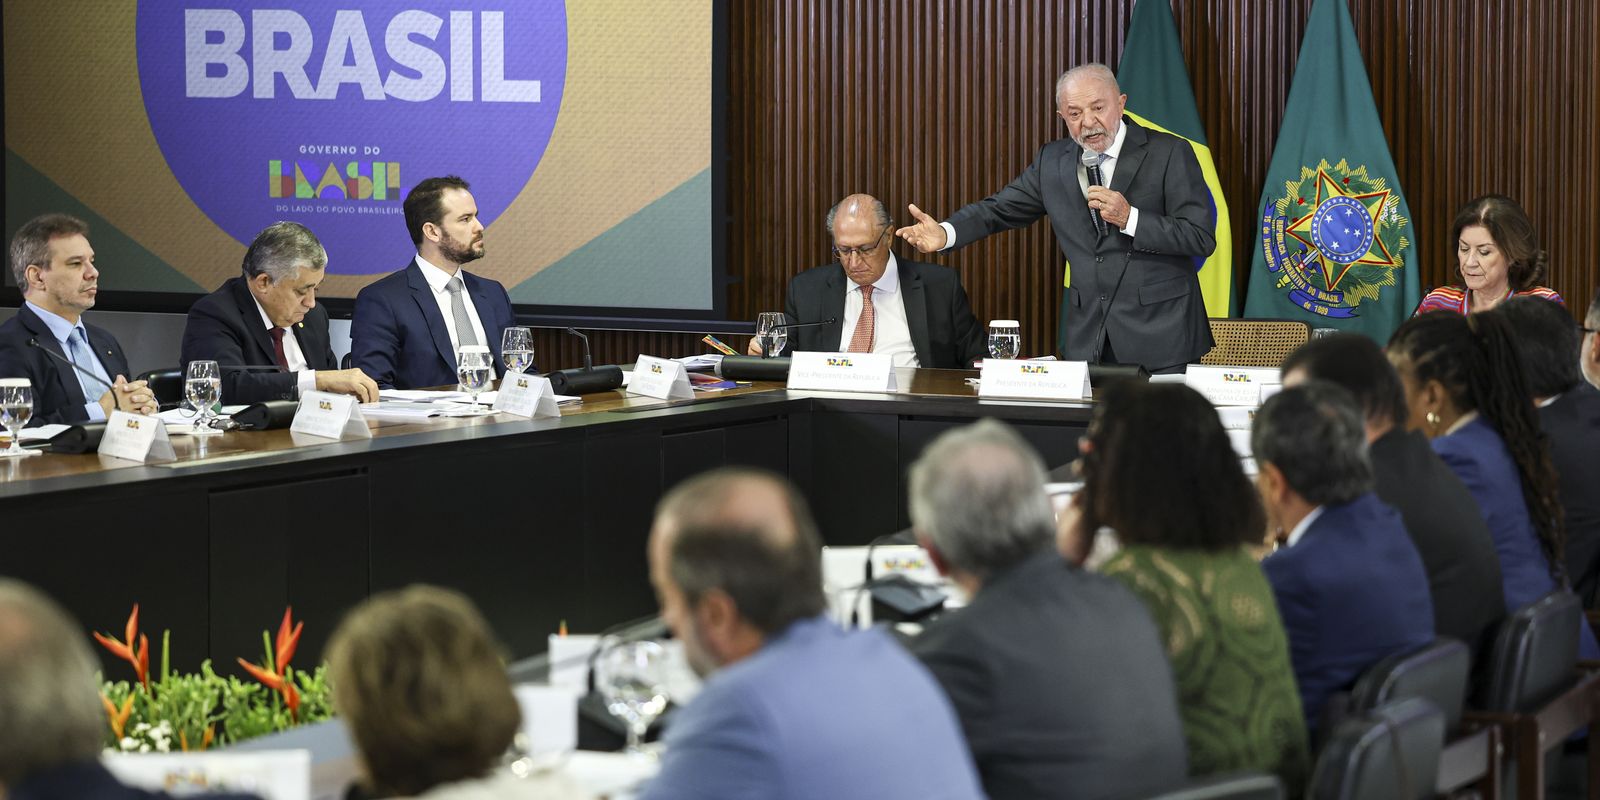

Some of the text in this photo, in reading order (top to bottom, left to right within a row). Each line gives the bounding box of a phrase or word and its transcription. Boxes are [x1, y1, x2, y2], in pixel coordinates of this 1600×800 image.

[185, 9, 541, 103] BRASIL
[299, 145, 381, 155] GOVERNO DO
[276, 205, 289, 213] DO
[291, 205, 314, 213] LADO
[316, 205, 329, 214] DO
[331, 206, 355, 214] POVO
[1281, 257, 1306, 290] FEDERATIVA
[1317, 291, 1340, 303] BRASIL
[1314, 305, 1329, 316] 1889
